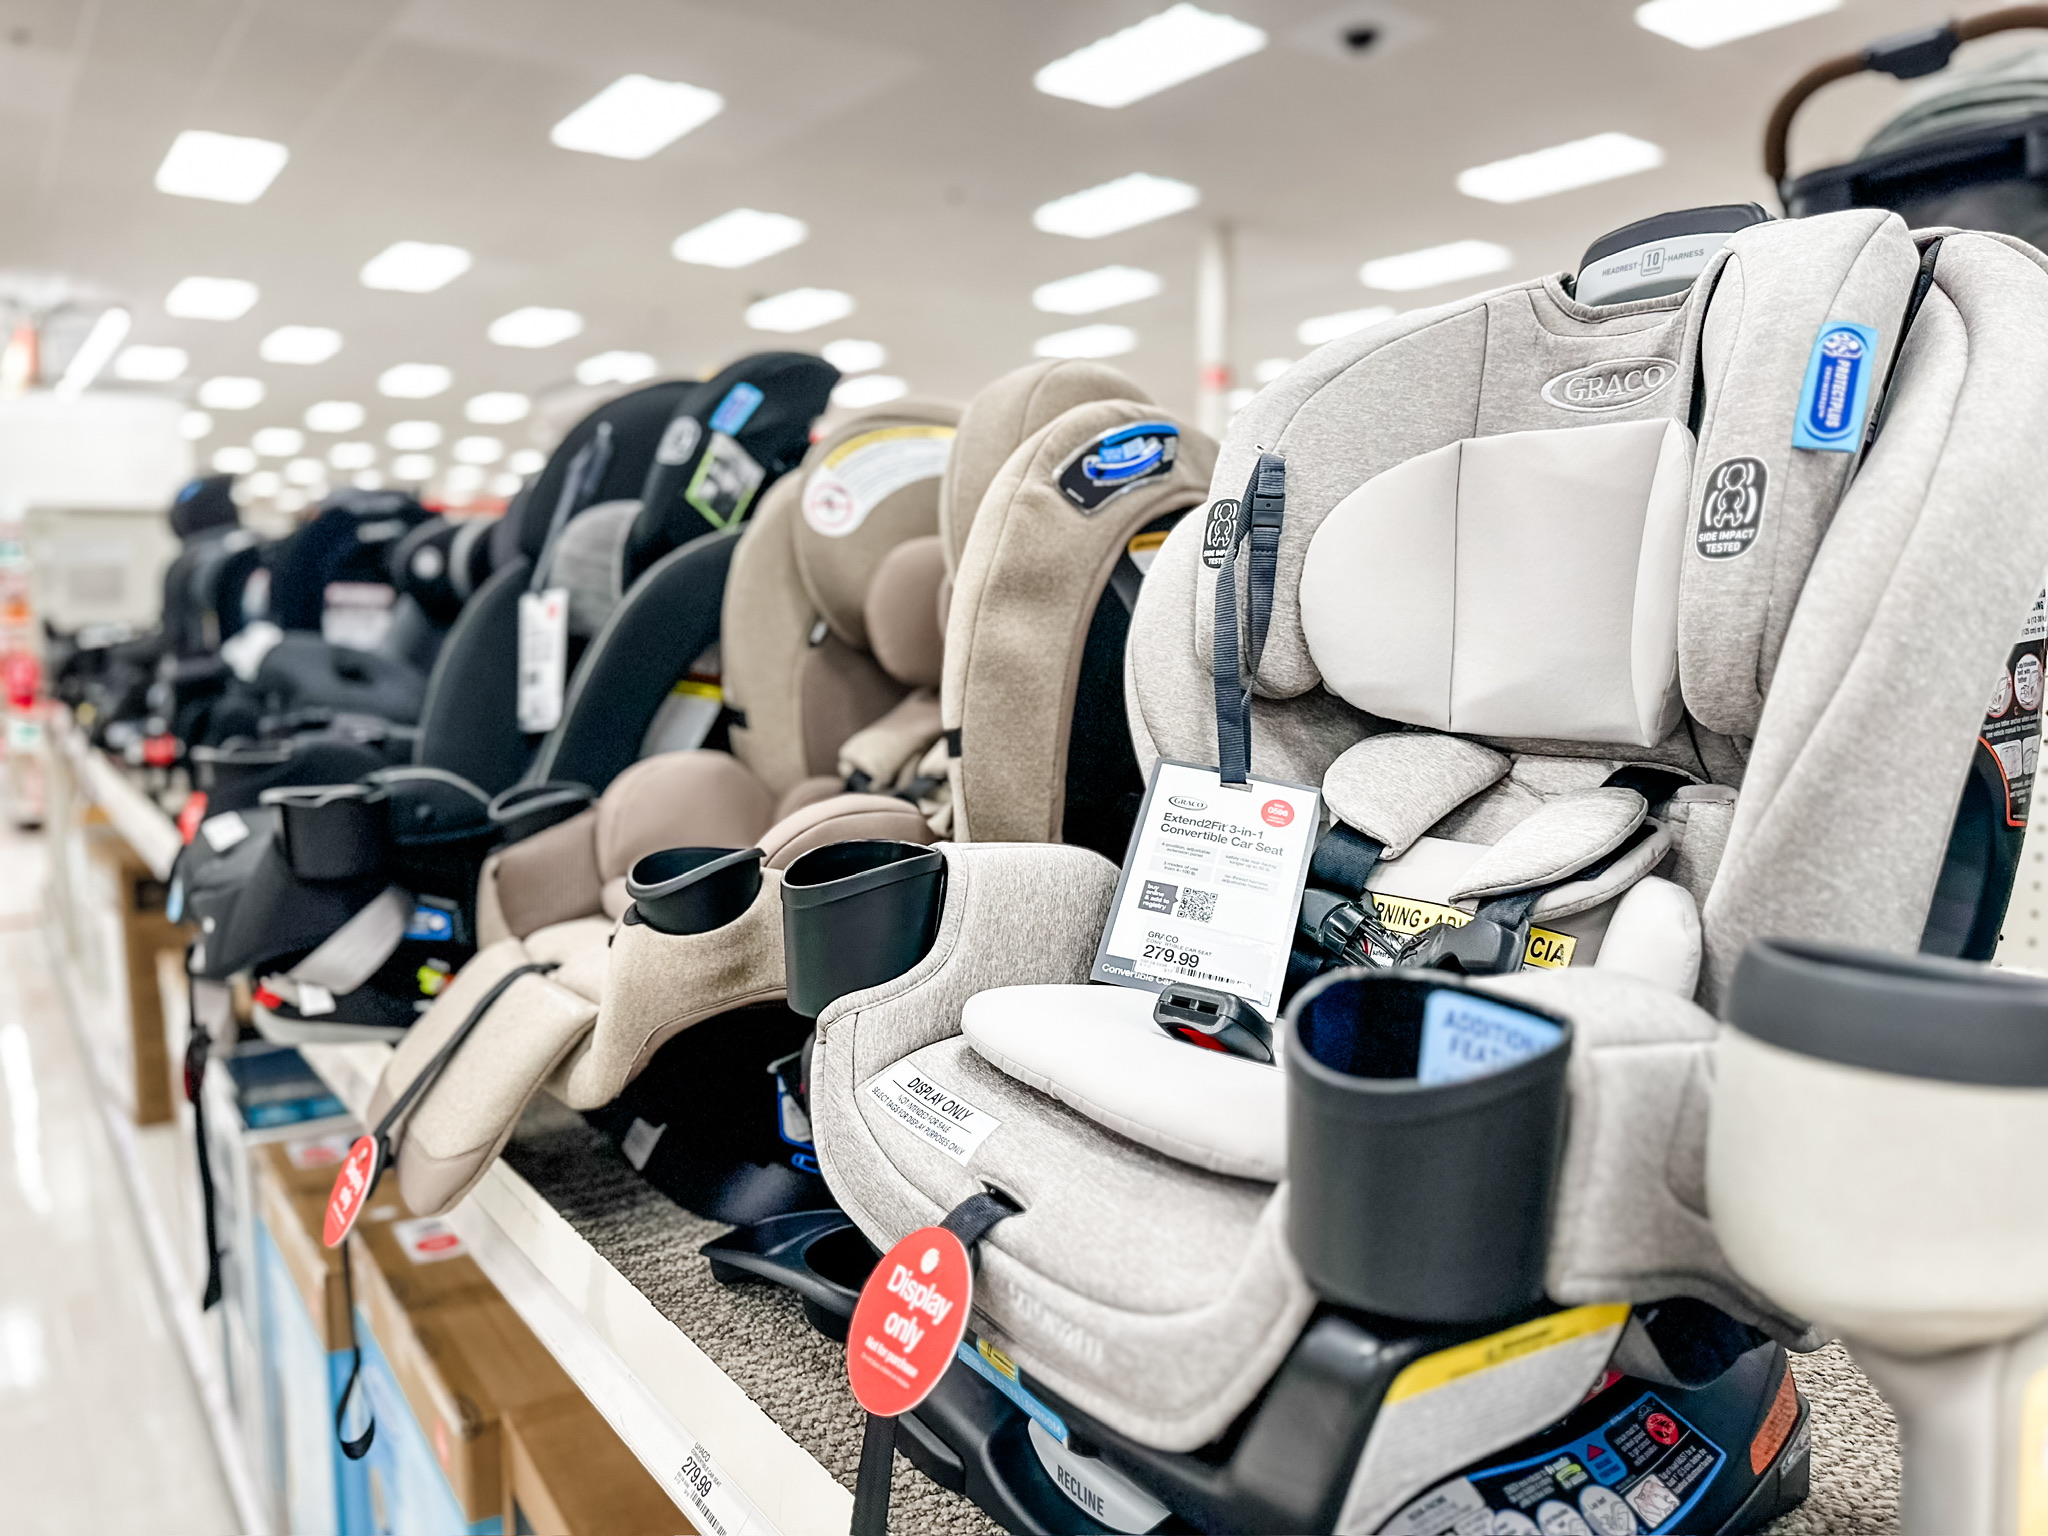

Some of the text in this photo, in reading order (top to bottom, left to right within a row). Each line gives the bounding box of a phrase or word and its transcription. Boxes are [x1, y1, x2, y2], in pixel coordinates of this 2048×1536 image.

[1602, 249, 1704, 276] HEADREST 10 HARNESS
[1564, 366, 1666, 401] GRACO
[1698, 528, 1755, 542] SIDE IMPACT
[1706, 541, 1741, 553] TESTED
[1173, 797, 1204, 808] GRACO
[1160, 823, 1284, 856] Convertible Car Seat
[1229, 824, 1264, 839] 3-in-1
[1143, 944, 1199, 968] 279.99
[897, 1094, 951, 1134] NOT INTENDED FOR SALE
[907, 1077, 974, 1122] DISPLAY ONLY
[871, 1086, 965, 1156] SELECT TAGS FOR DISPLAY PURPOSES ONLY
[886, 1264, 953, 1326] Display
[884, 1312, 925, 1354] only
[681, 1456, 712, 1497] 279.99
[1057, 1464, 1105, 1517] RECLINE
